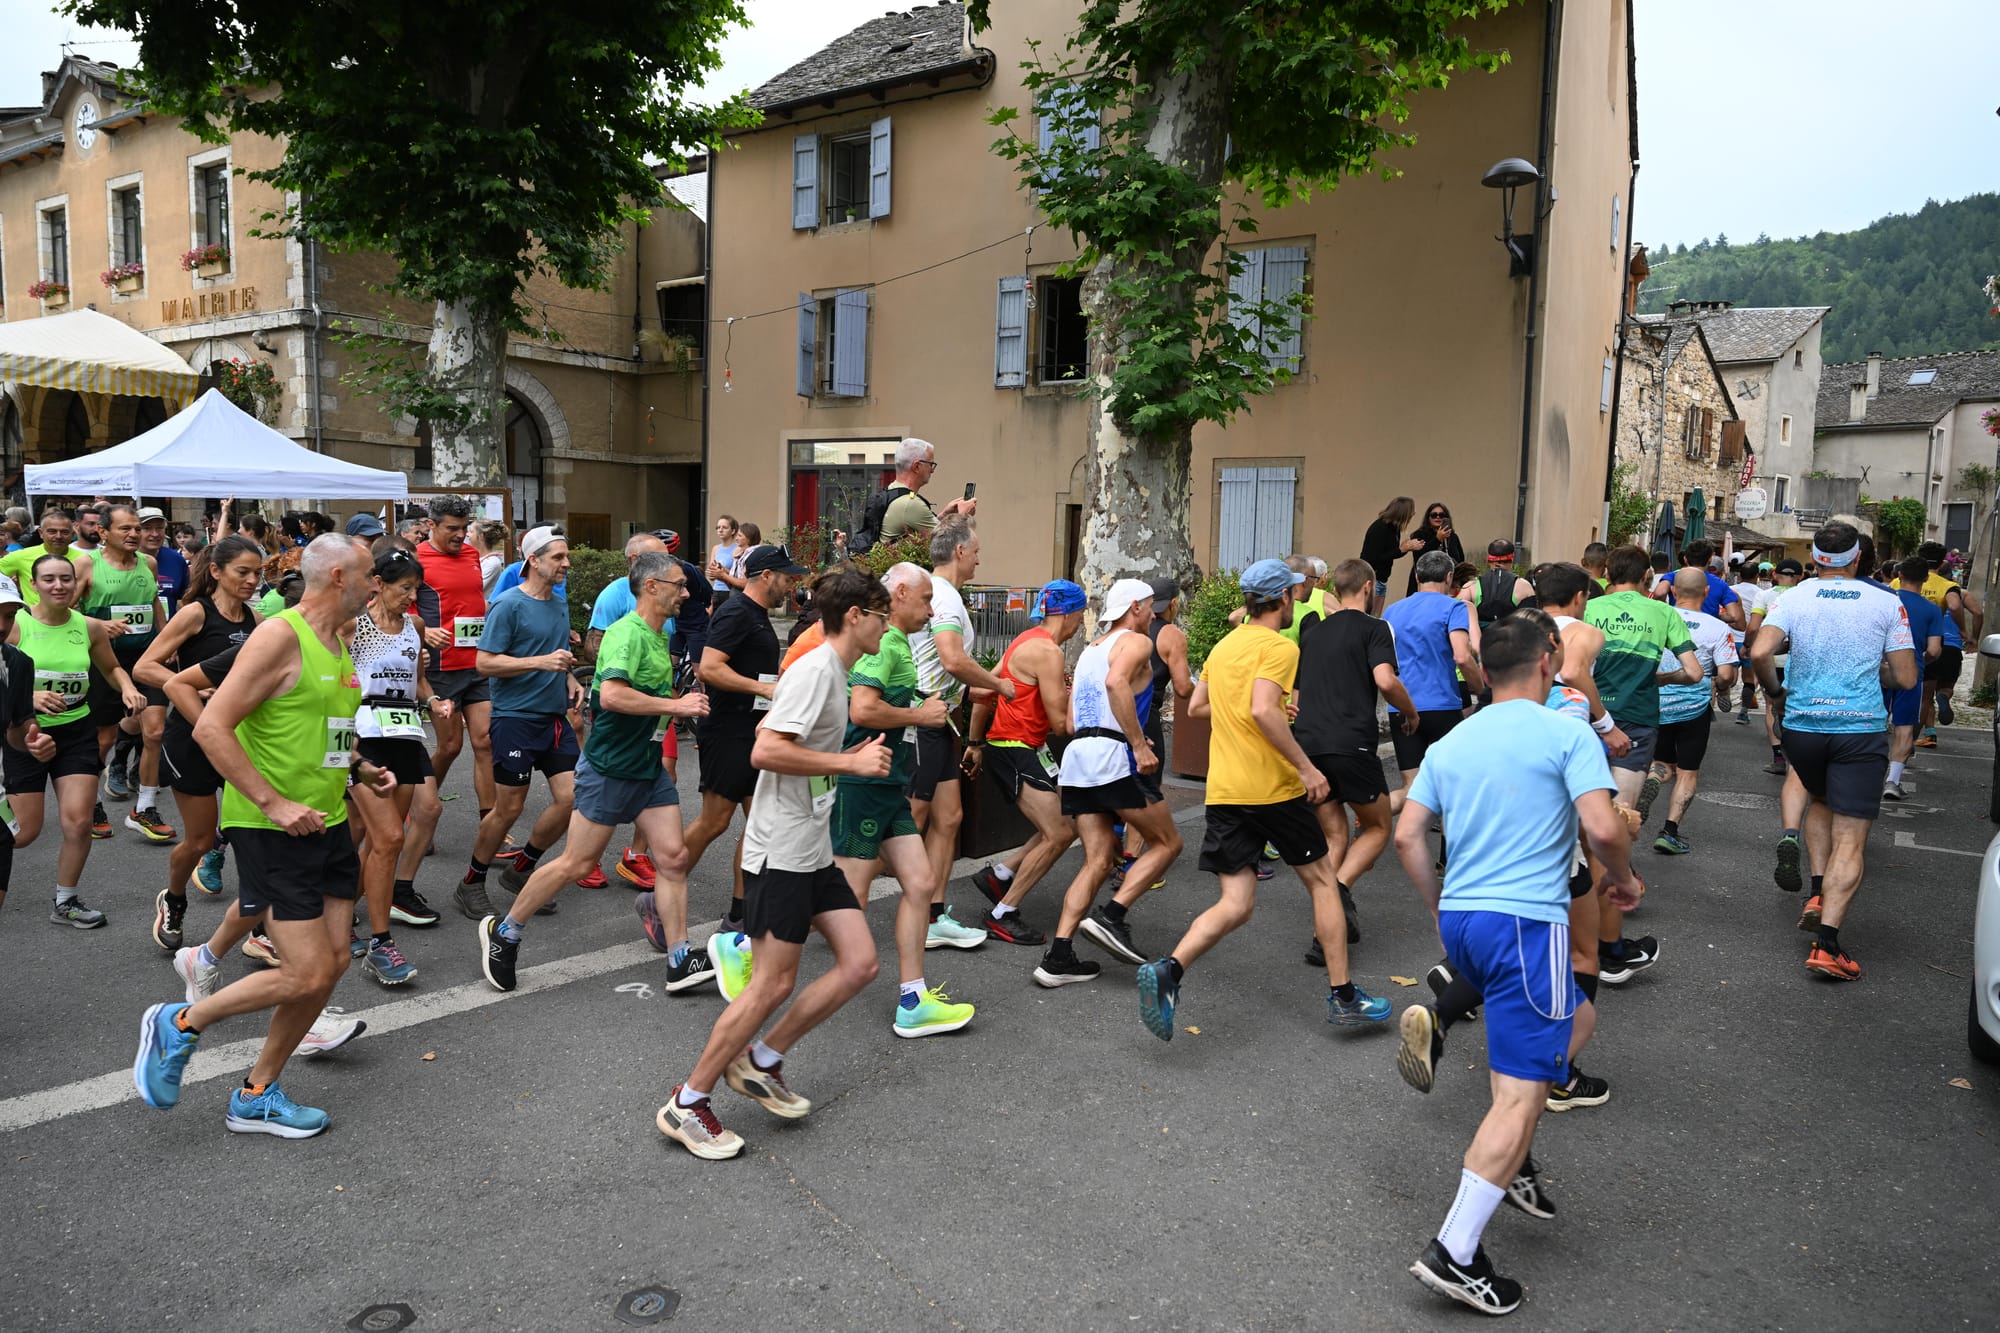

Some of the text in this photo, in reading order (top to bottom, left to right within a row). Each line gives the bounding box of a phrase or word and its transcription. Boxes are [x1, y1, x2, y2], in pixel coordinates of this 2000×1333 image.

[161, 286, 256, 323] MAIRIE
[1741, 455, 1755, 486] TABAC
[1816, 588, 1861, 600] MARCO
[124, 612, 145, 625] 30
[1595, 616, 1653, 636] Marvejols
[42, 680, 82, 695] 130
[1811, 697, 1848, 706] TRAILS
[389, 711, 411, 725] 57
[334, 730, 355, 751] 10
